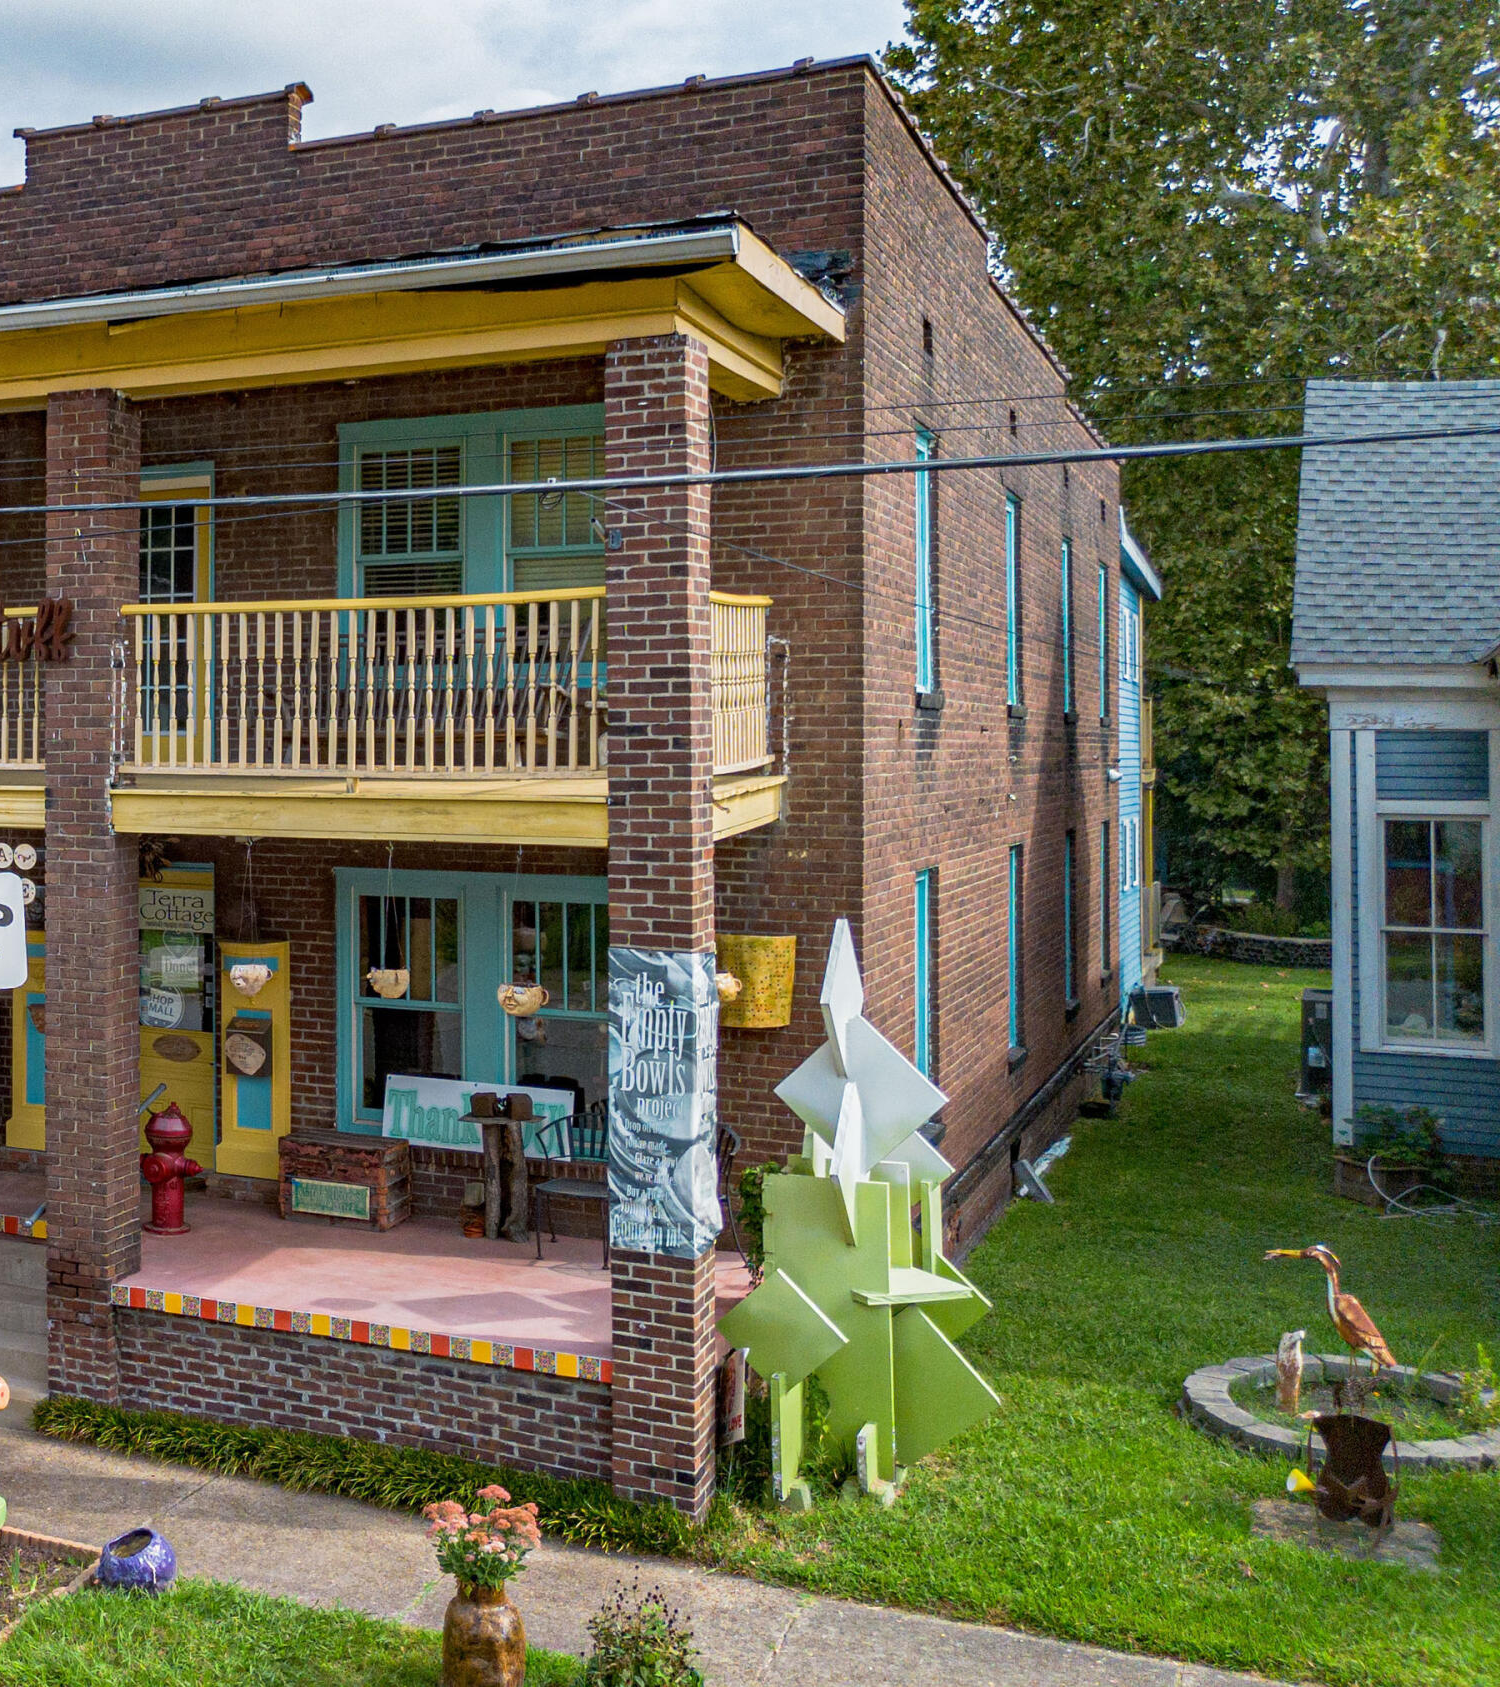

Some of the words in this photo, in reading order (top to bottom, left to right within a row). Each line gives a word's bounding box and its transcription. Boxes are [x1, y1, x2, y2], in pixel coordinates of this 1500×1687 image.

[146, 889, 205, 908] Terra
[140, 903, 214, 930] Cottage
[149, 994, 174, 1007] HOP
[636, 972, 665, 1005] the
[148, 1003, 174, 1017] MALL
[621, 992, 688, 1061] Empty
[620, 1046, 686, 1097] Bowls
